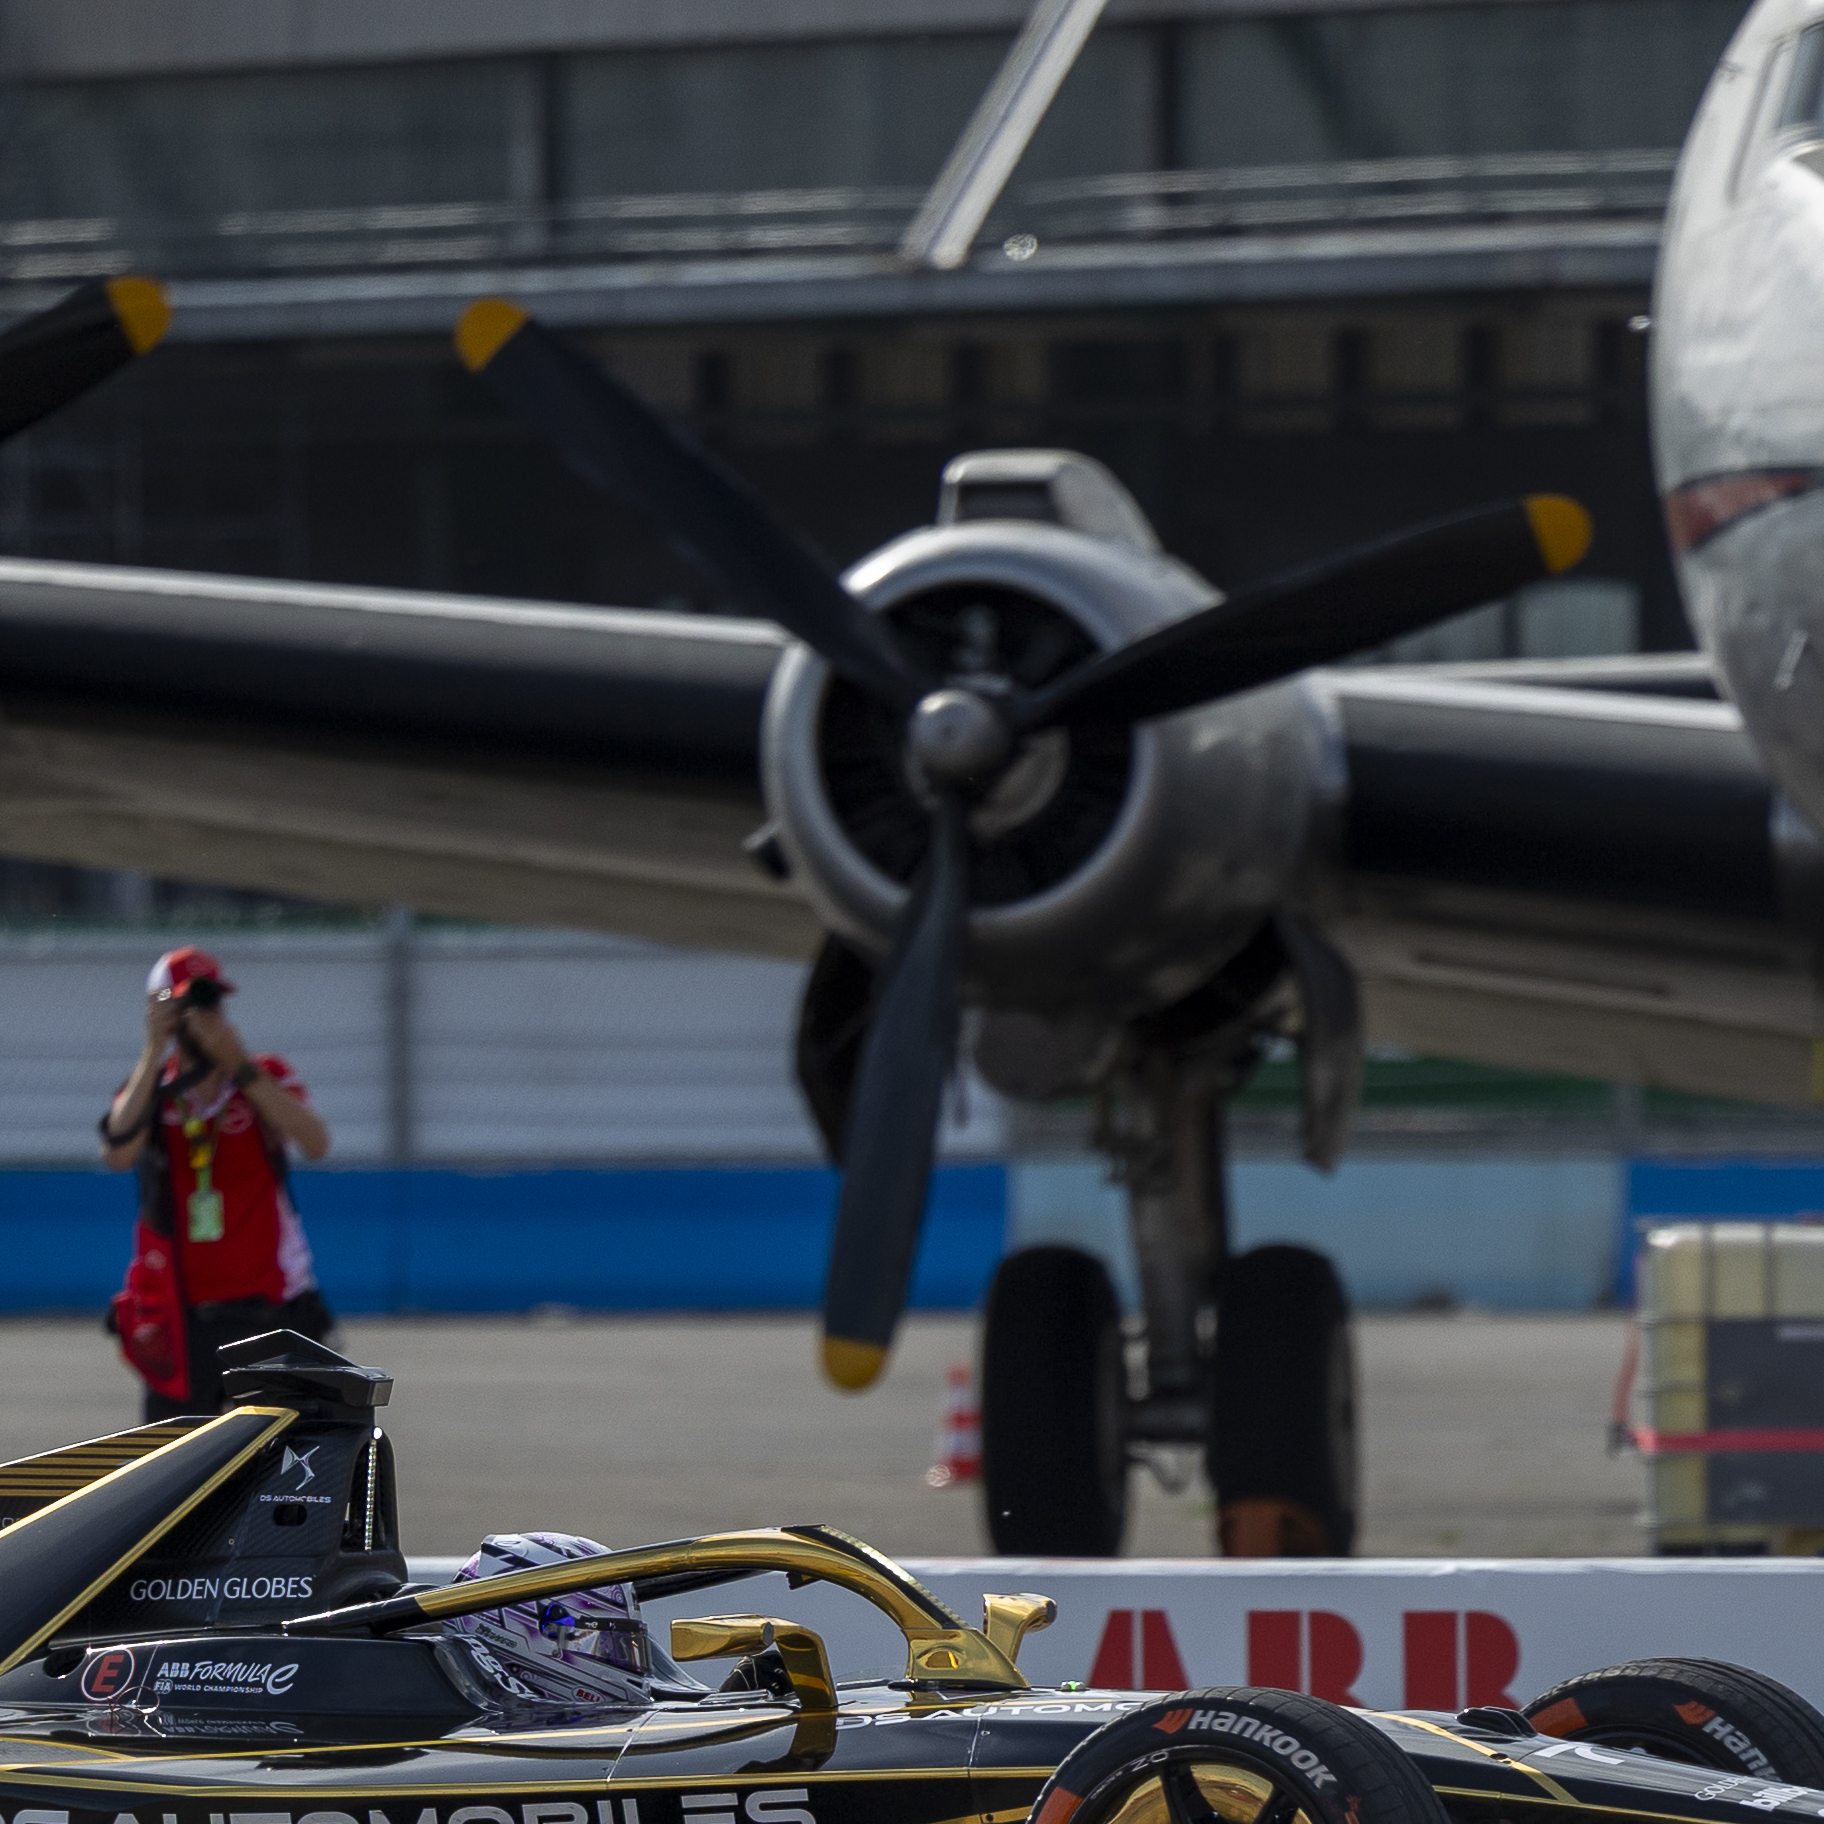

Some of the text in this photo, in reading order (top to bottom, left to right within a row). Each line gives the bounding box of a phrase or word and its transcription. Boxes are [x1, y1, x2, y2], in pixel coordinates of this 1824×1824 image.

[130, 1576, 313, 1601] GOLDEN GLOBES
[157, 1662, 190, 1678] ABB
[189, 1661, 272, 1683] FORMULA
[835, 1702, 1144, 1731] DS AUTOMO
